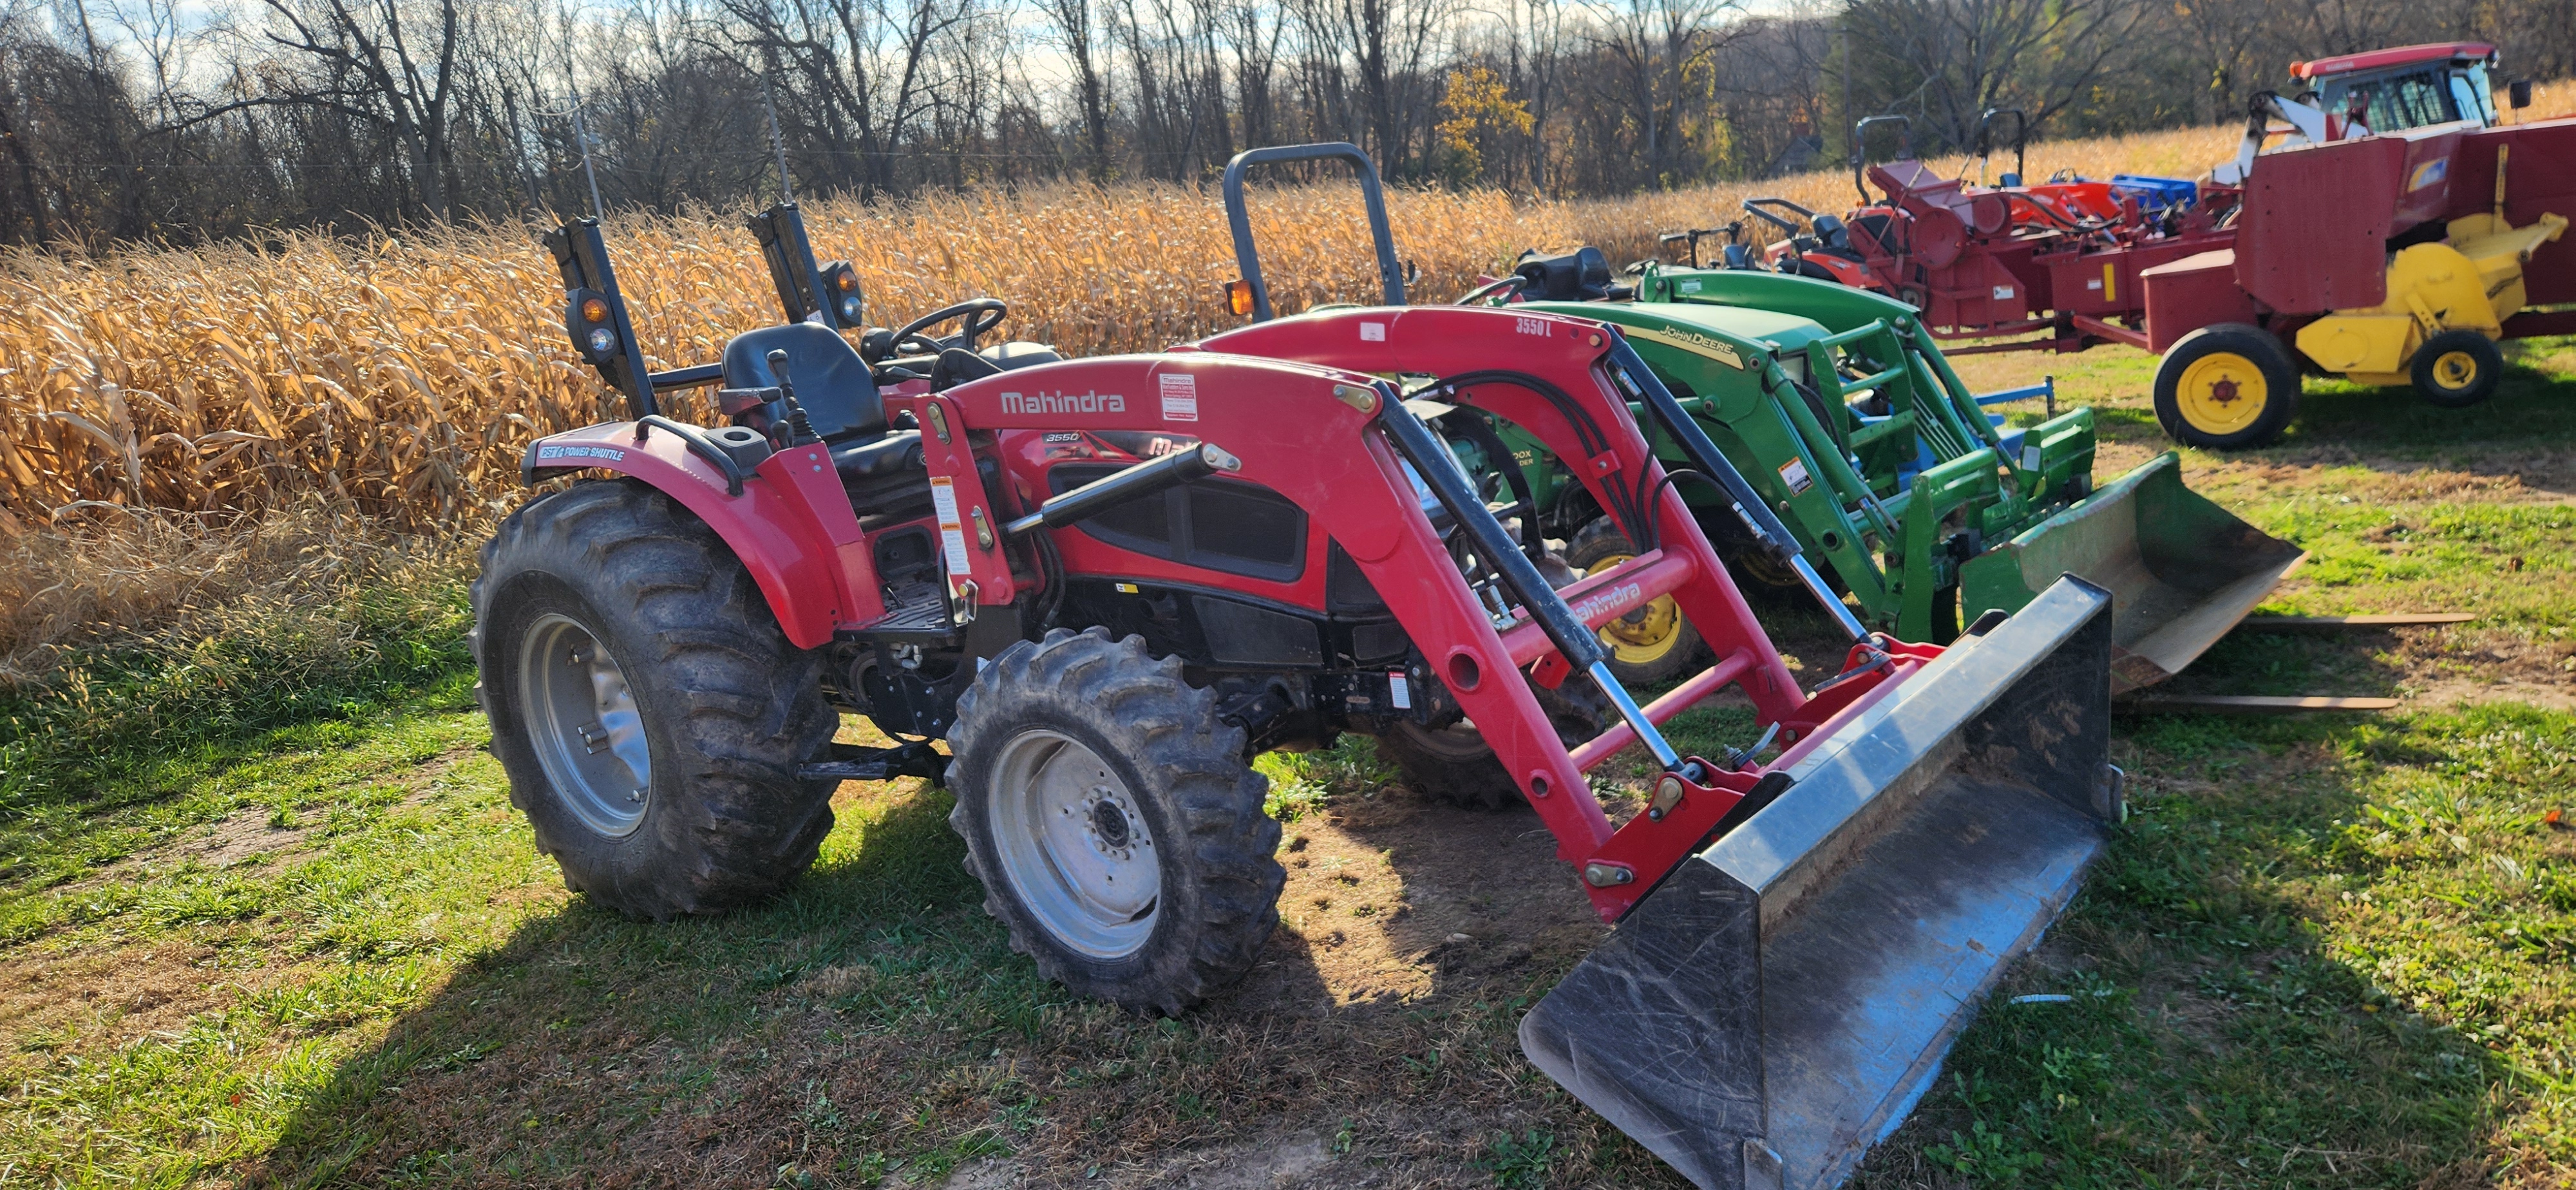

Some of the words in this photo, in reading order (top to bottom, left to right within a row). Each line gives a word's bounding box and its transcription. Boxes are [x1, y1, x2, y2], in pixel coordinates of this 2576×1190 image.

[1660, 325, 1692, 343] JOHN
[1692, 332, 1734, 354] DEERE
[1001, 390, 1126, 414] Mahindra
[1046, 433, 1079, 442] 3550
[564, 446, 589, 457] POWER
[590, 448, 625, 462] SHUTTLE
[1575, 582, 1640, 621] ahindra
